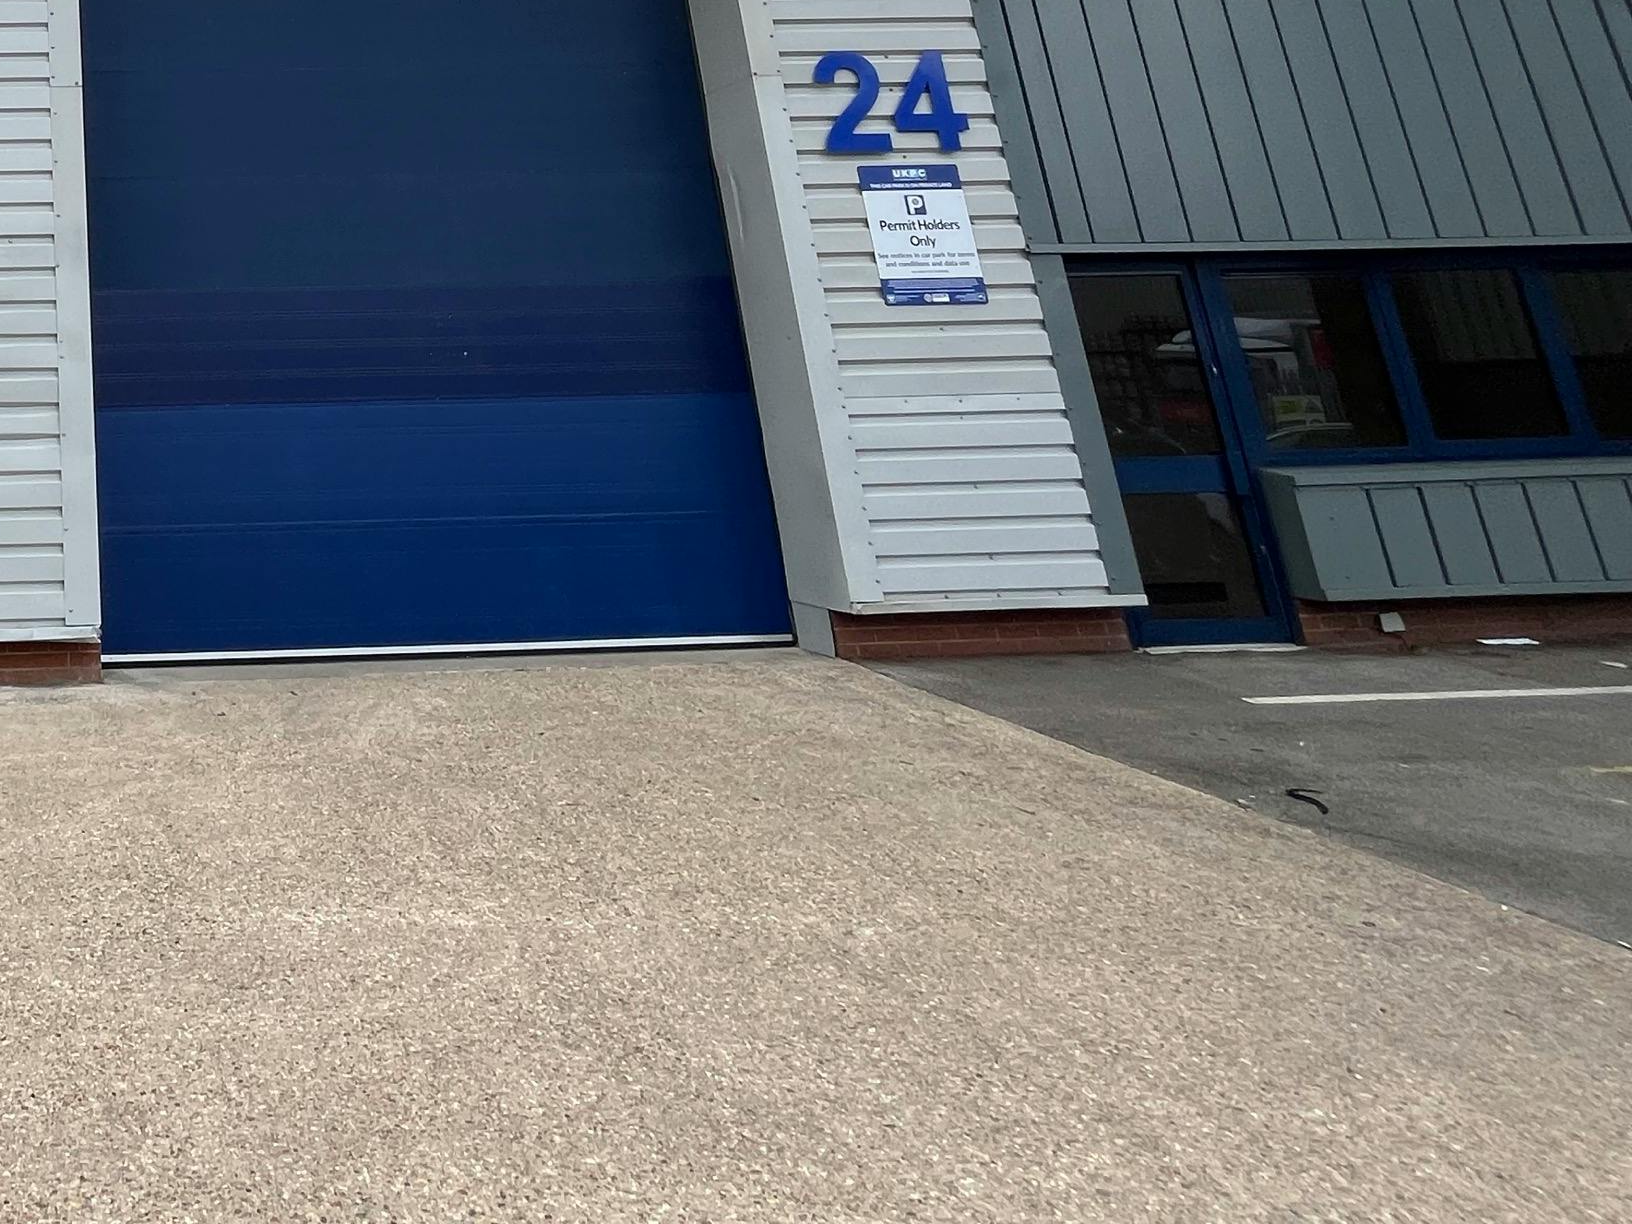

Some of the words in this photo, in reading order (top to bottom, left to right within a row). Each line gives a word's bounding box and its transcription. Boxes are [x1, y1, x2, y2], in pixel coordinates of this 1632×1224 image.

[812, 50, 970, 154] 24
[892, 168, 926, 178] UKPC
[879, 219, 916, 231] Permit
[917, 219, 961, 230] Holders
[910, 235, 936, 248] Only
